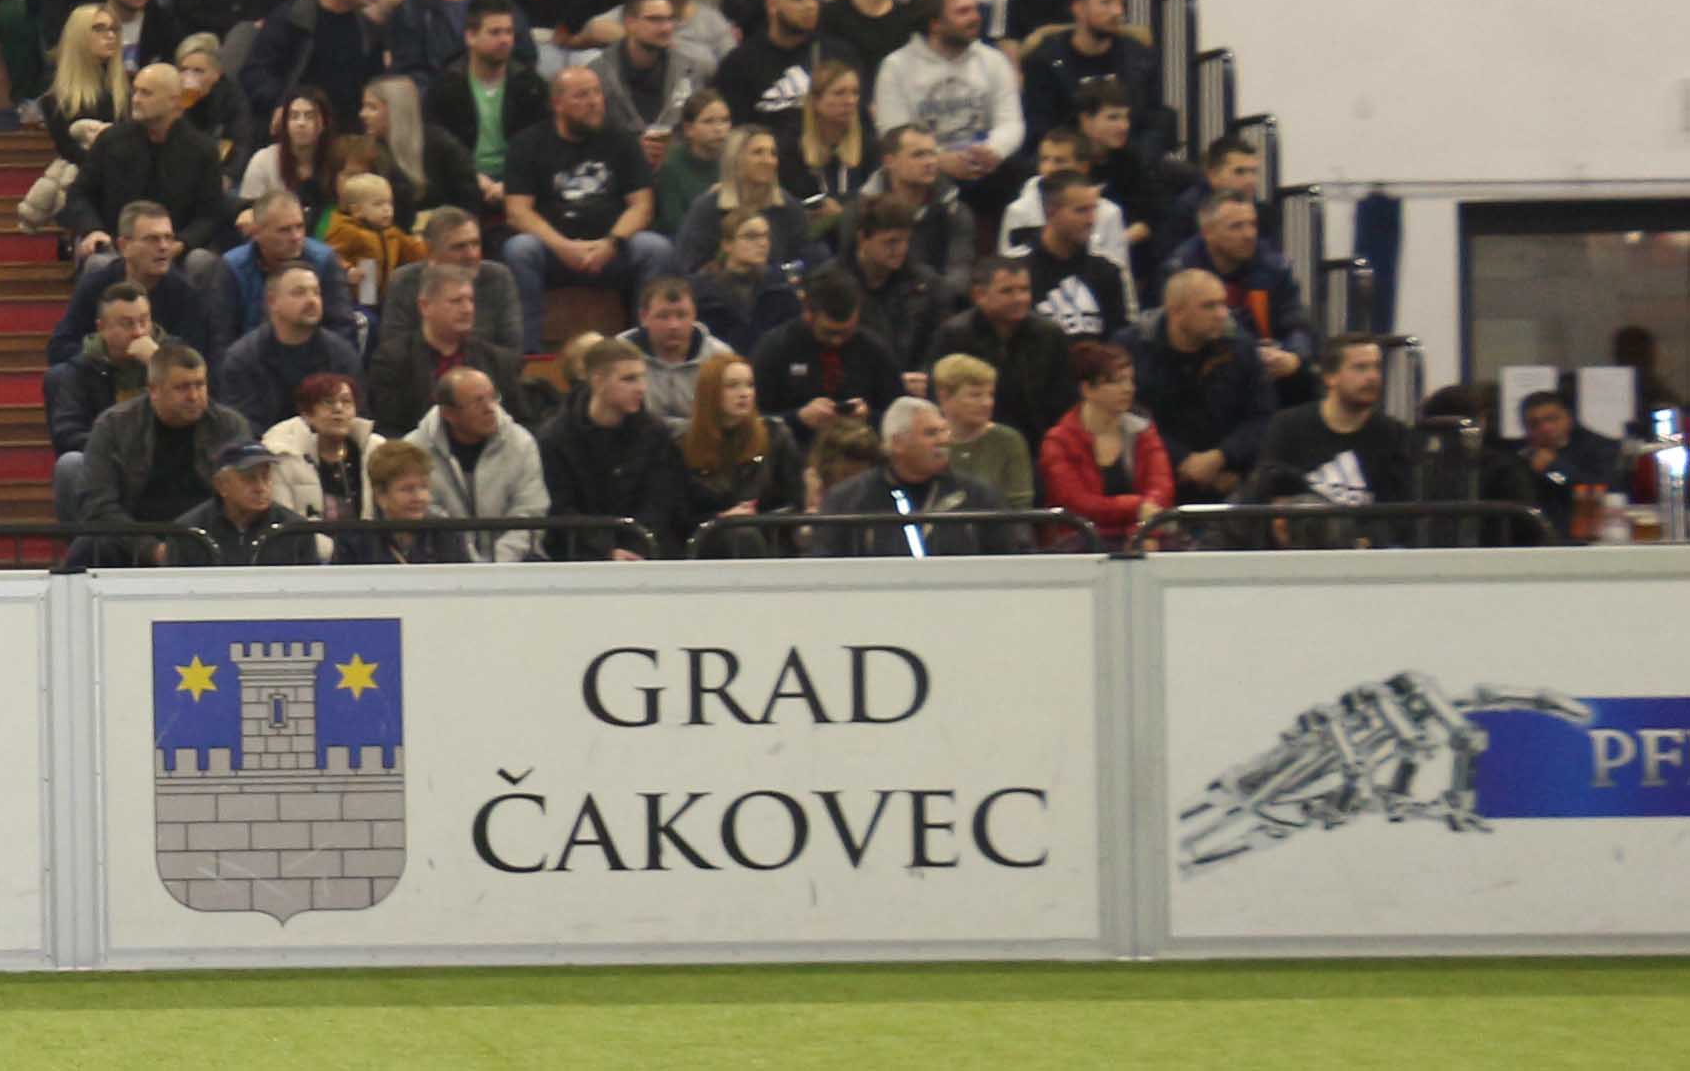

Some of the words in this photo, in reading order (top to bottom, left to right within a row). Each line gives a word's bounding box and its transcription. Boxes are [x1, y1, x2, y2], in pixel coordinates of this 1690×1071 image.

[581, 644, 931, 729] GRAD
[1587, 728, 1690, 787] PF
[471, 767, 1049, 874] ČAKOVEC
